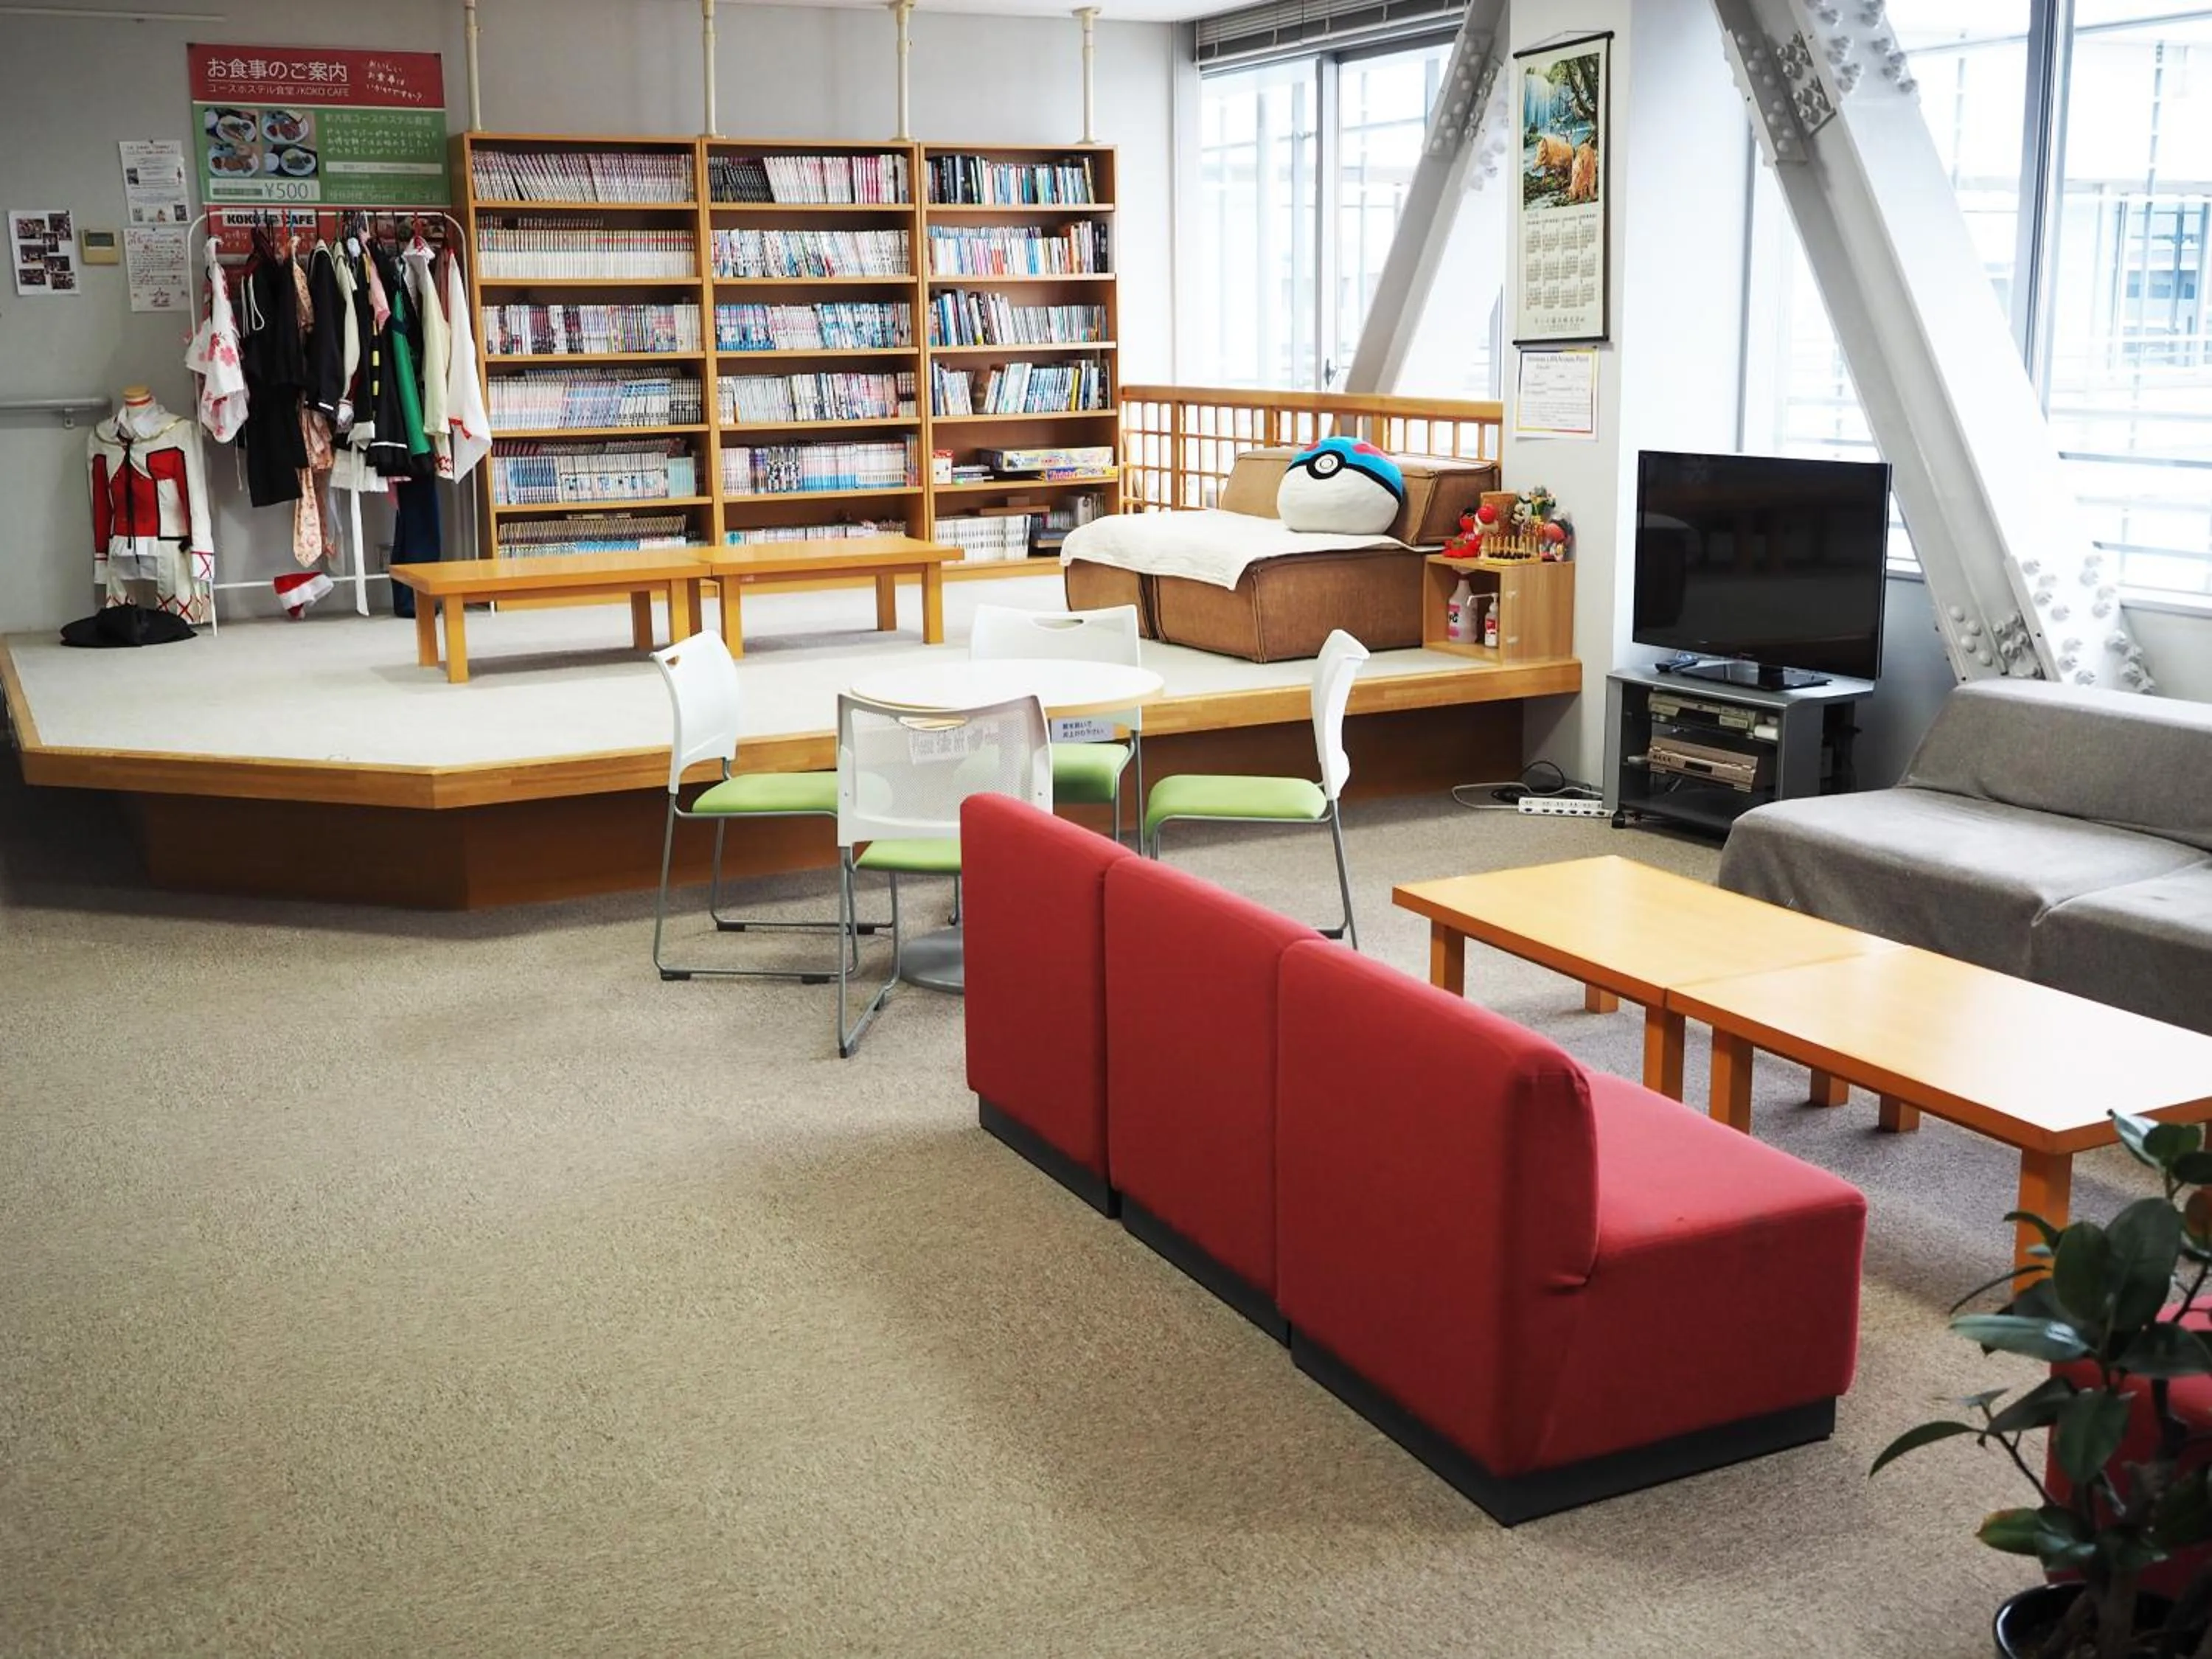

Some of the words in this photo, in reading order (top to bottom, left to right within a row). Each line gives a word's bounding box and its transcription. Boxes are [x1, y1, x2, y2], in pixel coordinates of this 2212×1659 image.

[206, 58, 348, 83] お食事のご案内
[327, 87, 349, 97] CAFE
[265, 182, 309, 200] ¥500
